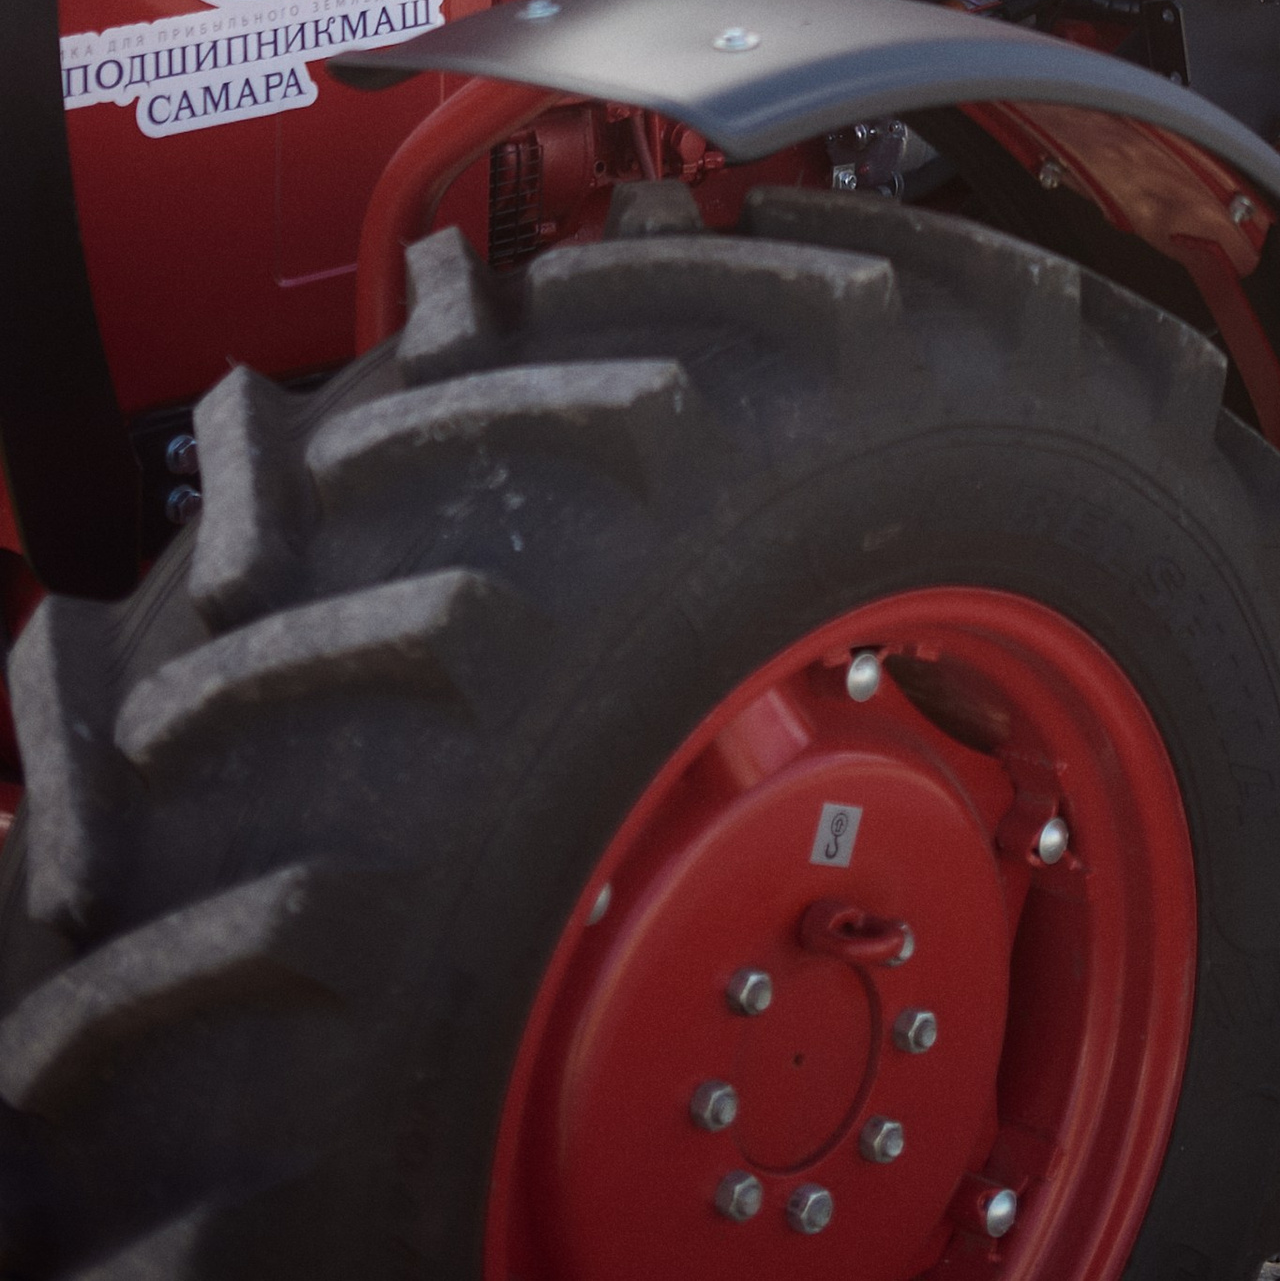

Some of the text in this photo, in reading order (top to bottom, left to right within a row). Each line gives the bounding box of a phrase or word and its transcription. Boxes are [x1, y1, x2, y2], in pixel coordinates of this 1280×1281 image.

[107, 34, 146, 53] ДЛЯ
[157, 5, 300, 42] ПРИБЫЛЬНОГО
[147, 66, 307, 126] САМАРА
